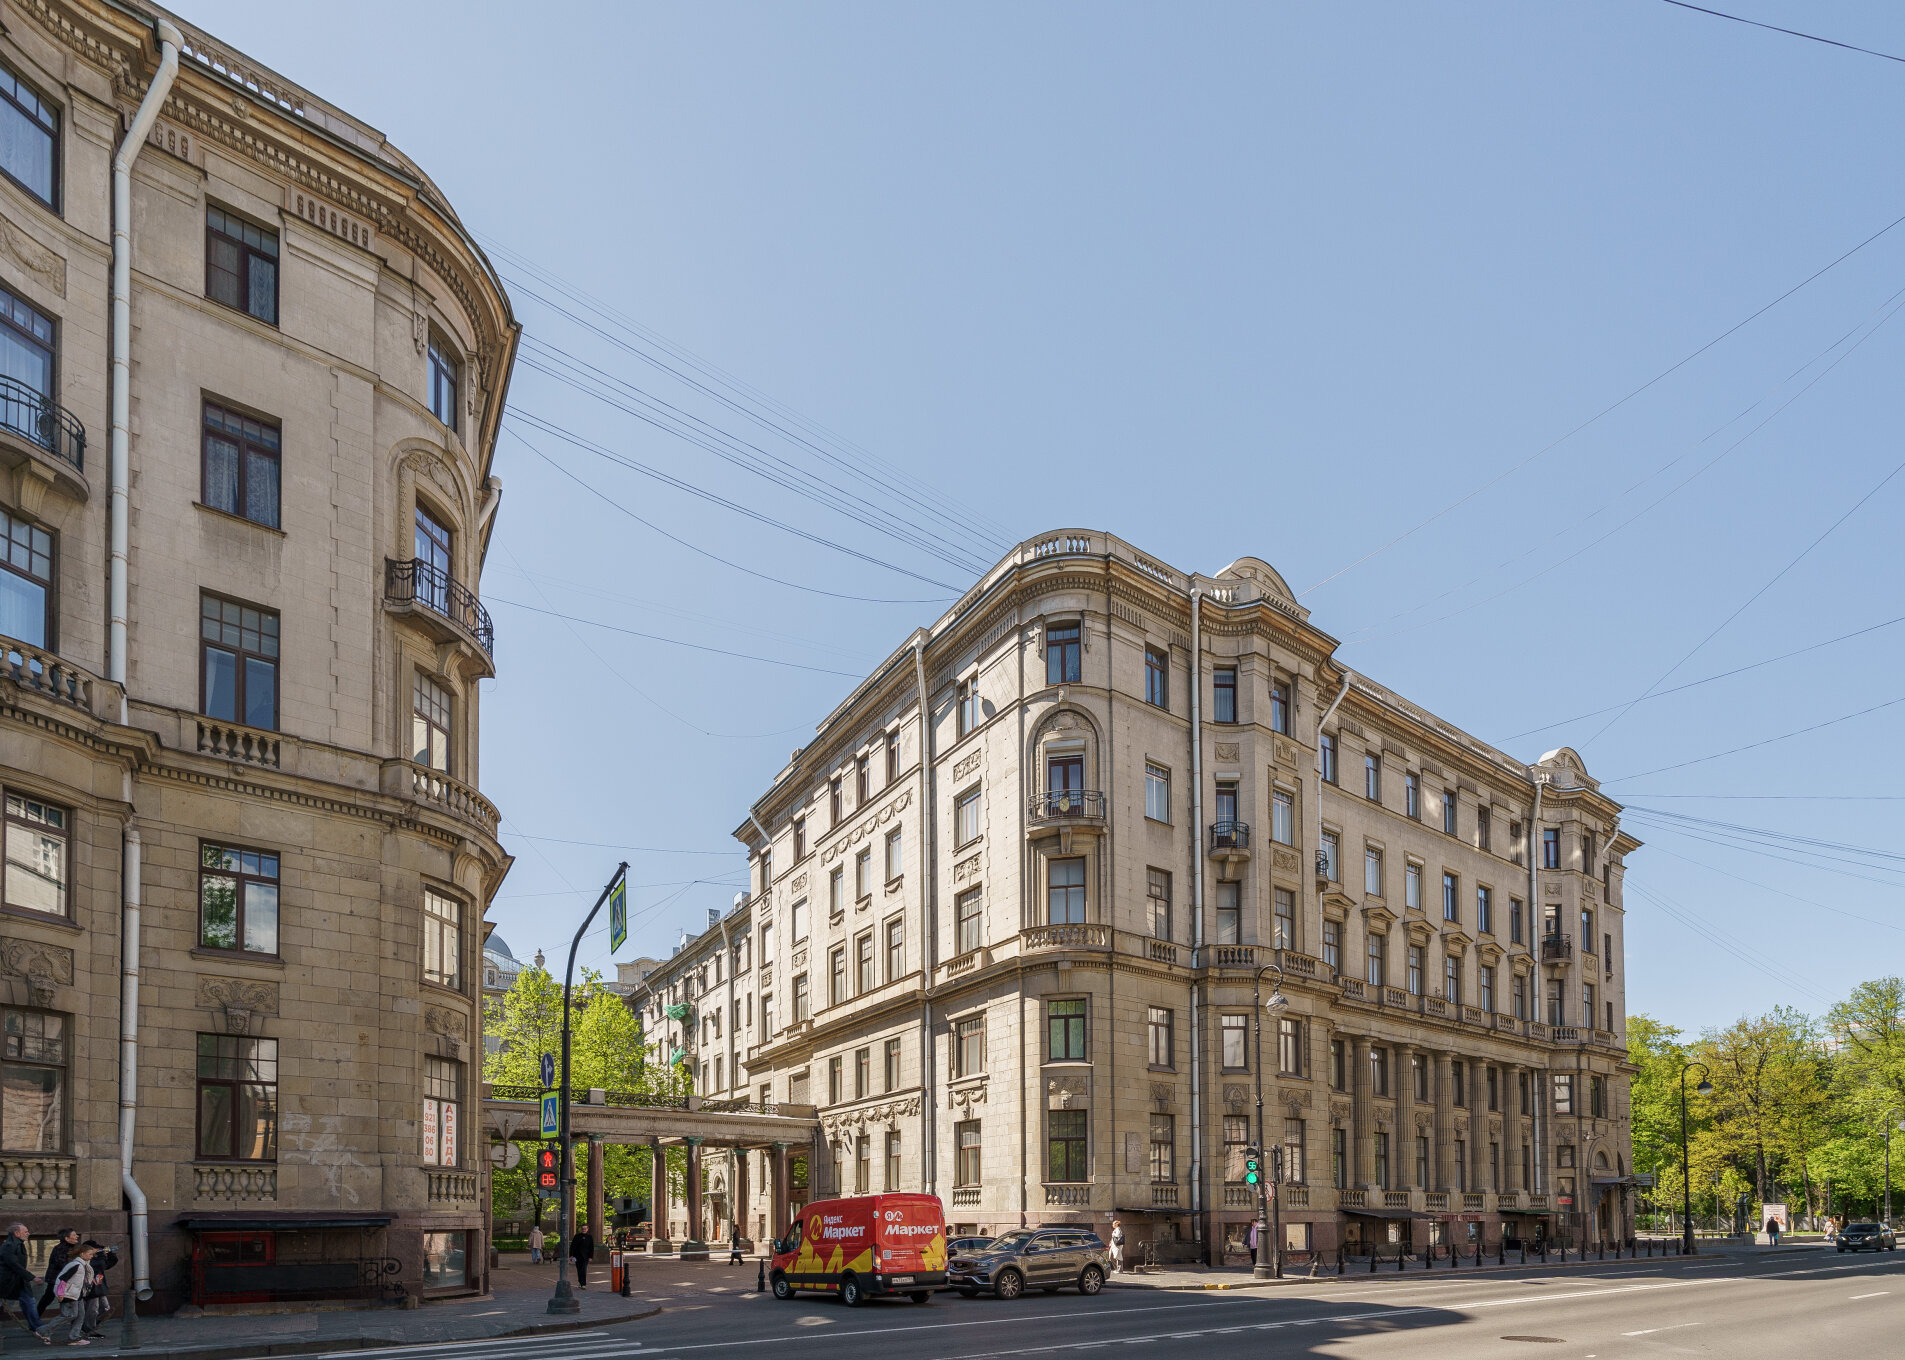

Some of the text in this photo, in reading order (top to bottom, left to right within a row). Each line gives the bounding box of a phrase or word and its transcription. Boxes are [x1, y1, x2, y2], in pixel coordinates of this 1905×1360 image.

[428, 1102, 432, 1110] 8
[425, 1113, 435, 1122] 921
[424, 1124, 435, 1134] 386
[425, 1136, 433, 1145] 06
[445, 1105, 453, 1166] АРЕНДА
[425, 1147, 433, 1156] 80
[542, 1174, 556, 1186] 85
[823, 1226, 865, 1240] Маркет
[885, 1224, 939, 1236] Маркет
